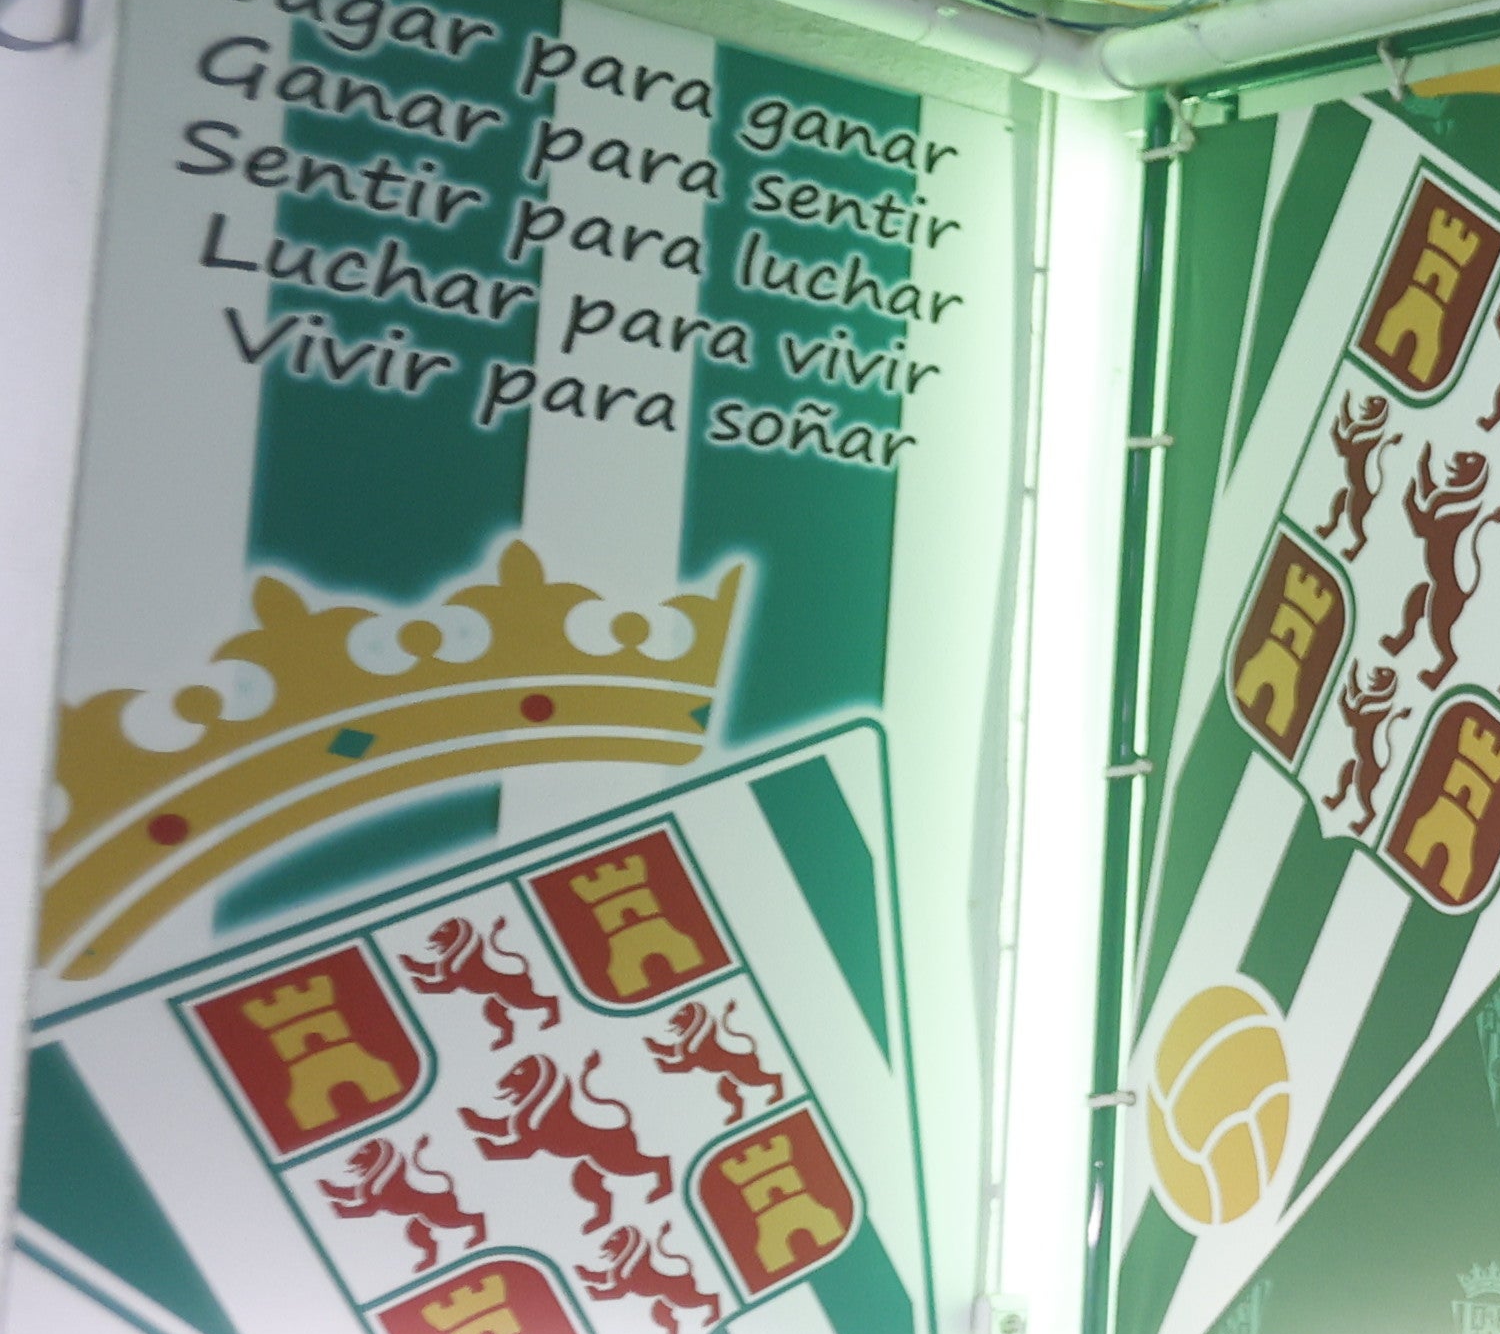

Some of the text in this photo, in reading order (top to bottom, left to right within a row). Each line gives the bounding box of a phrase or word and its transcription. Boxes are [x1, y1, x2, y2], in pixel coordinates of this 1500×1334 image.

[198, 34, 961, 251] Ganar para sentir
[519, 33, 713, 119] para
[739, 97, 959, 177] ganar
[176, 119, 965, 325] Sentir para luchar
[199, 212, 940, 397] Luchar para vivir
[224, 307, 919, 469] Vivir para soñar
